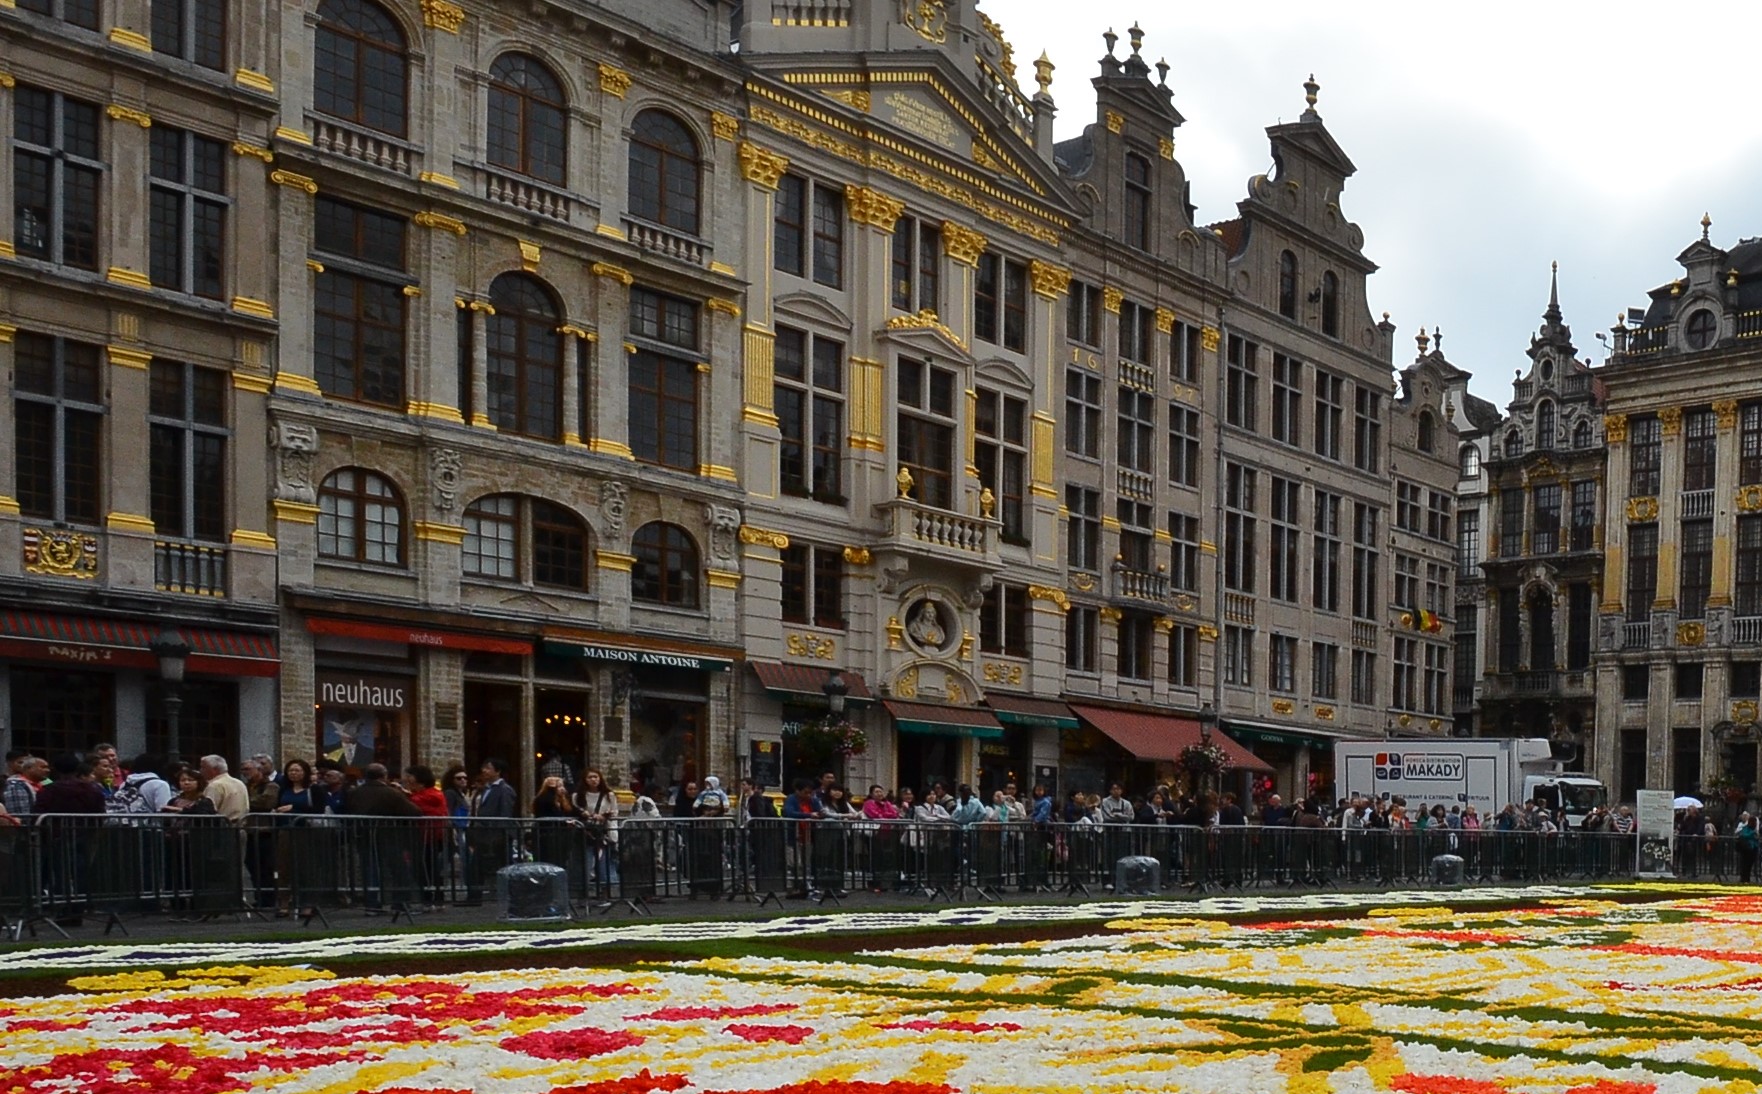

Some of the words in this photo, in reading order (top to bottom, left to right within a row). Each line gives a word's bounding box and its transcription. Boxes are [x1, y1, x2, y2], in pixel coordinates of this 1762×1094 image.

[409, 633, 444, 645] neuhaus
[583, 647, 637, 661] MAISON
[641, 654, 700, 669] ANTOINE
[322, 680, 404, 708] neuhaus
[1406, 763, 1461, 777] MAKADY
